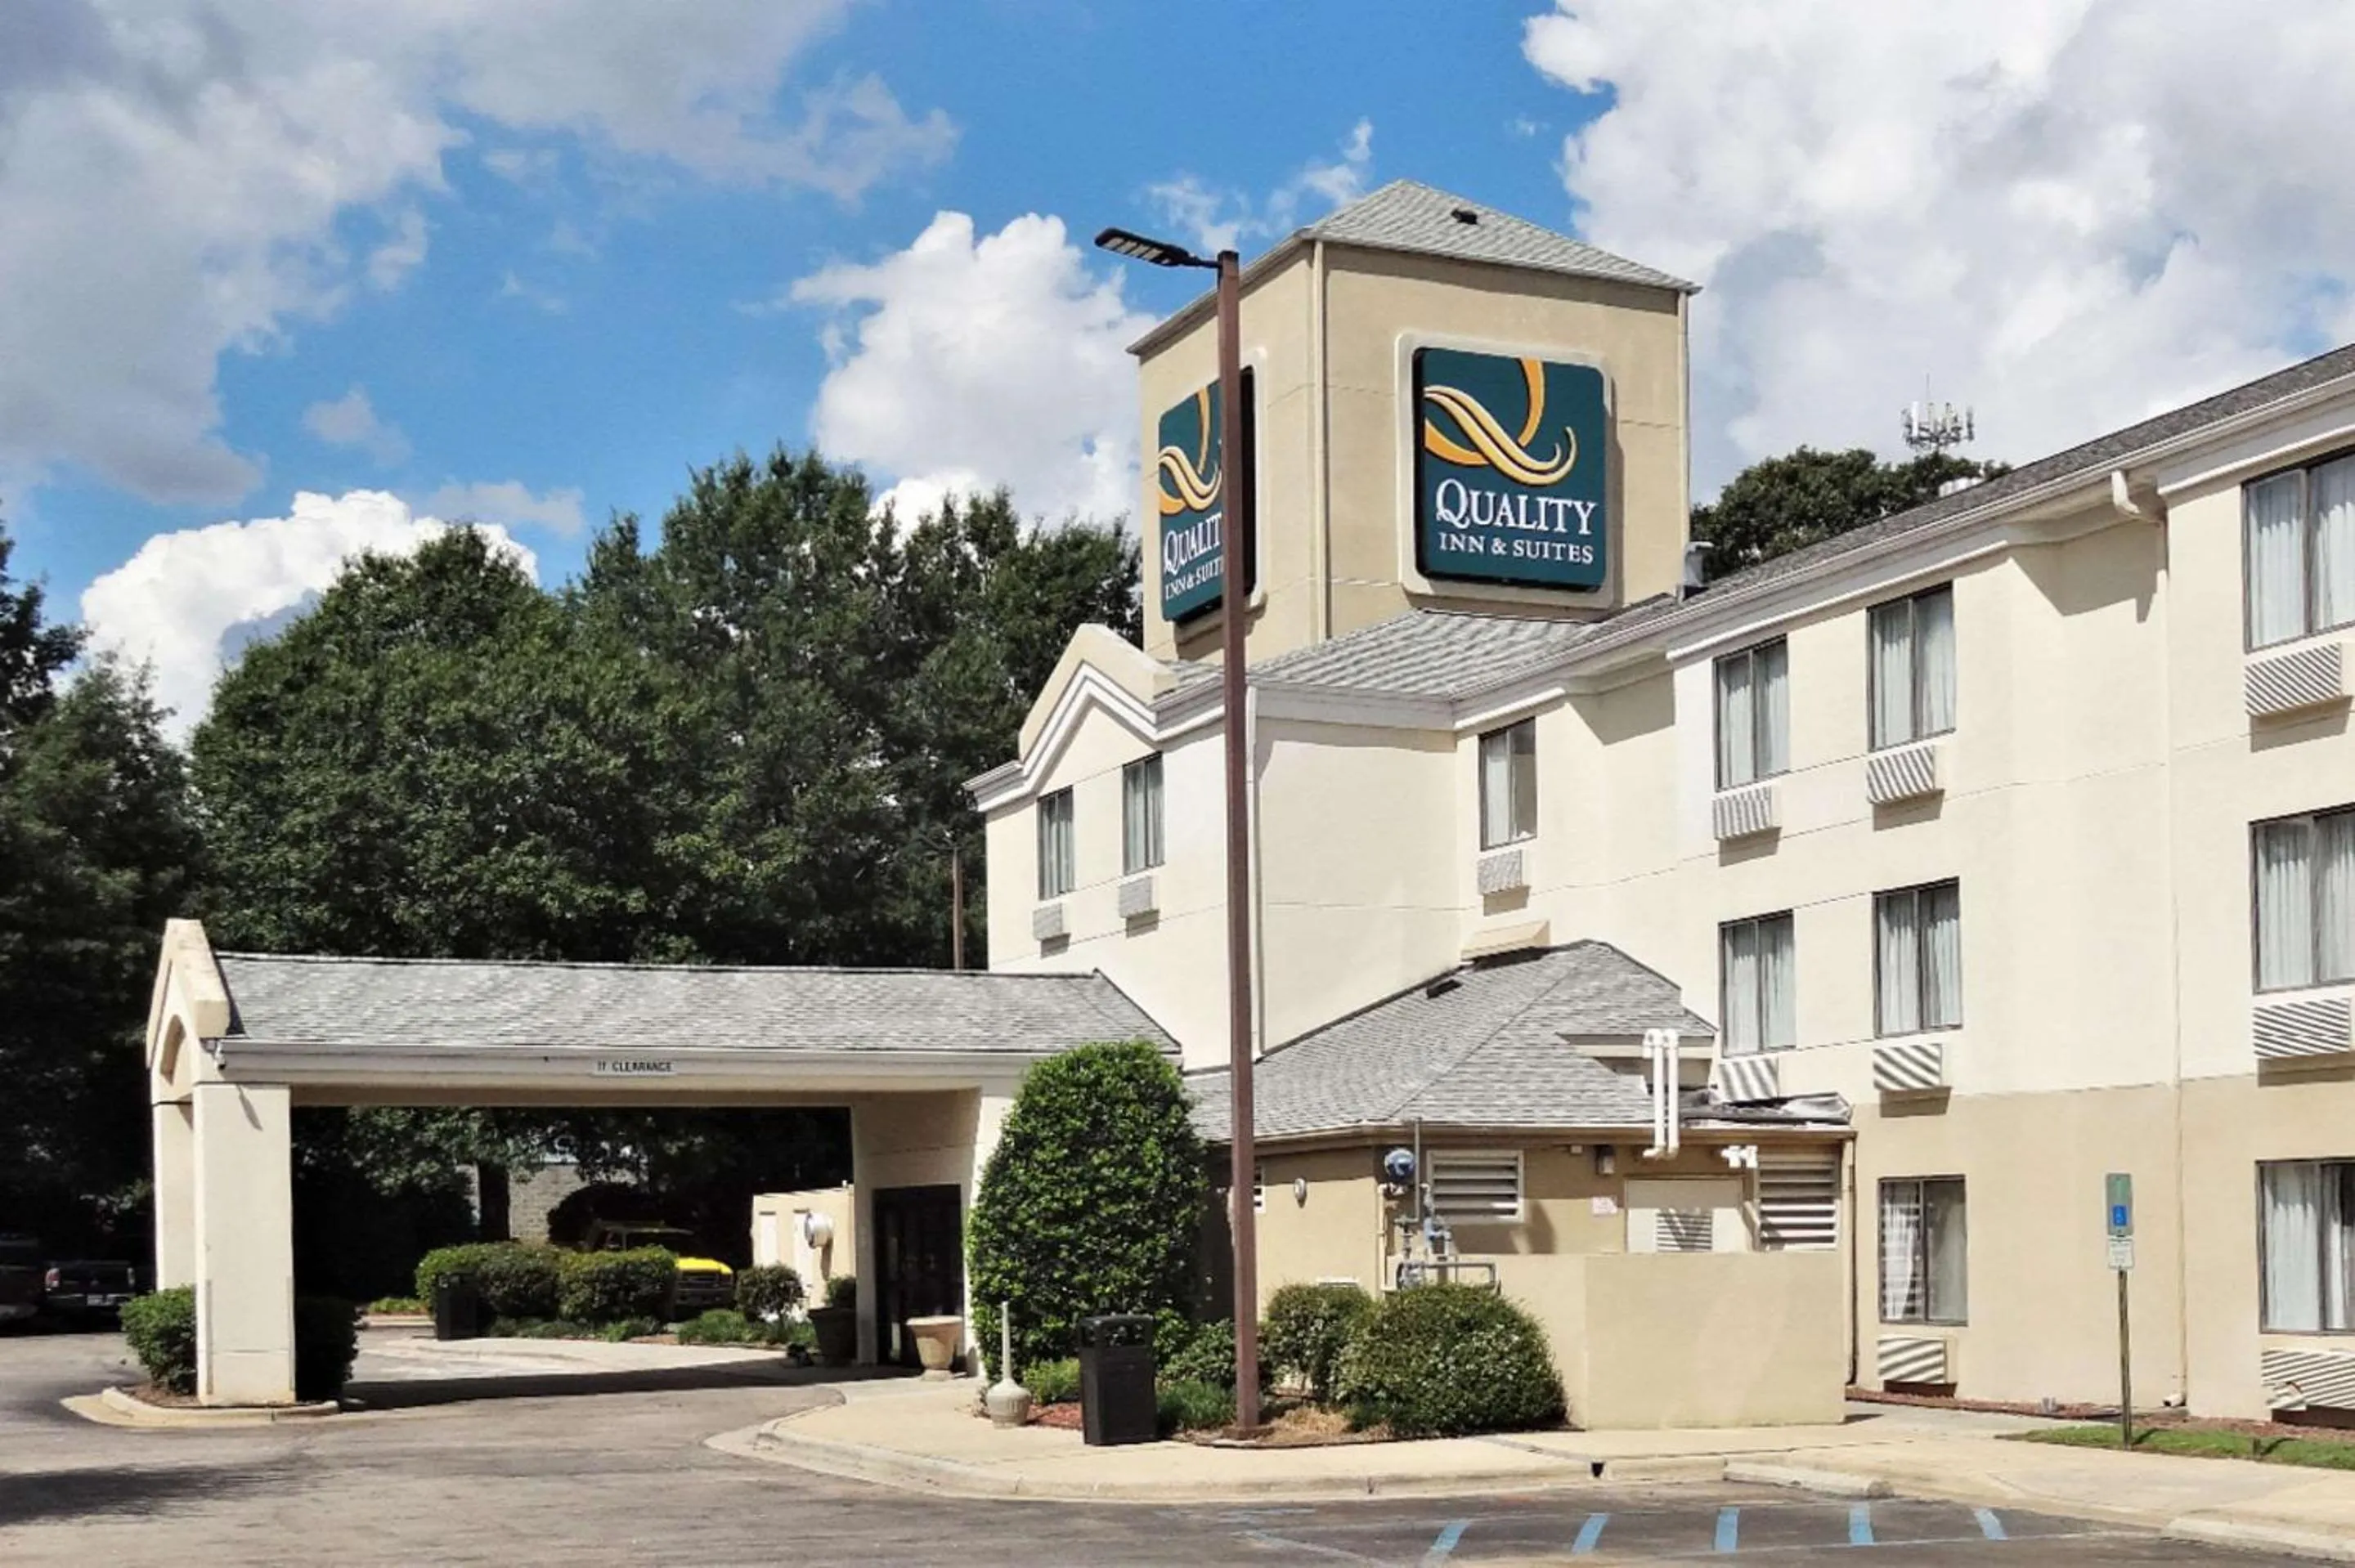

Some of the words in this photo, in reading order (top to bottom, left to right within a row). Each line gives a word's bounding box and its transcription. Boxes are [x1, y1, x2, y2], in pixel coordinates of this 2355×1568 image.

[1436, 478, 1597, 535] QUALITY
[1164, 512, 1222, 576] QUALIT
[1439, 532, 1485, 553] INN
[1491, 537, 1508, 555] &
[1513, 539, 1594, 564] SUITES
[1196, 556, 1223, 585] SUIT
